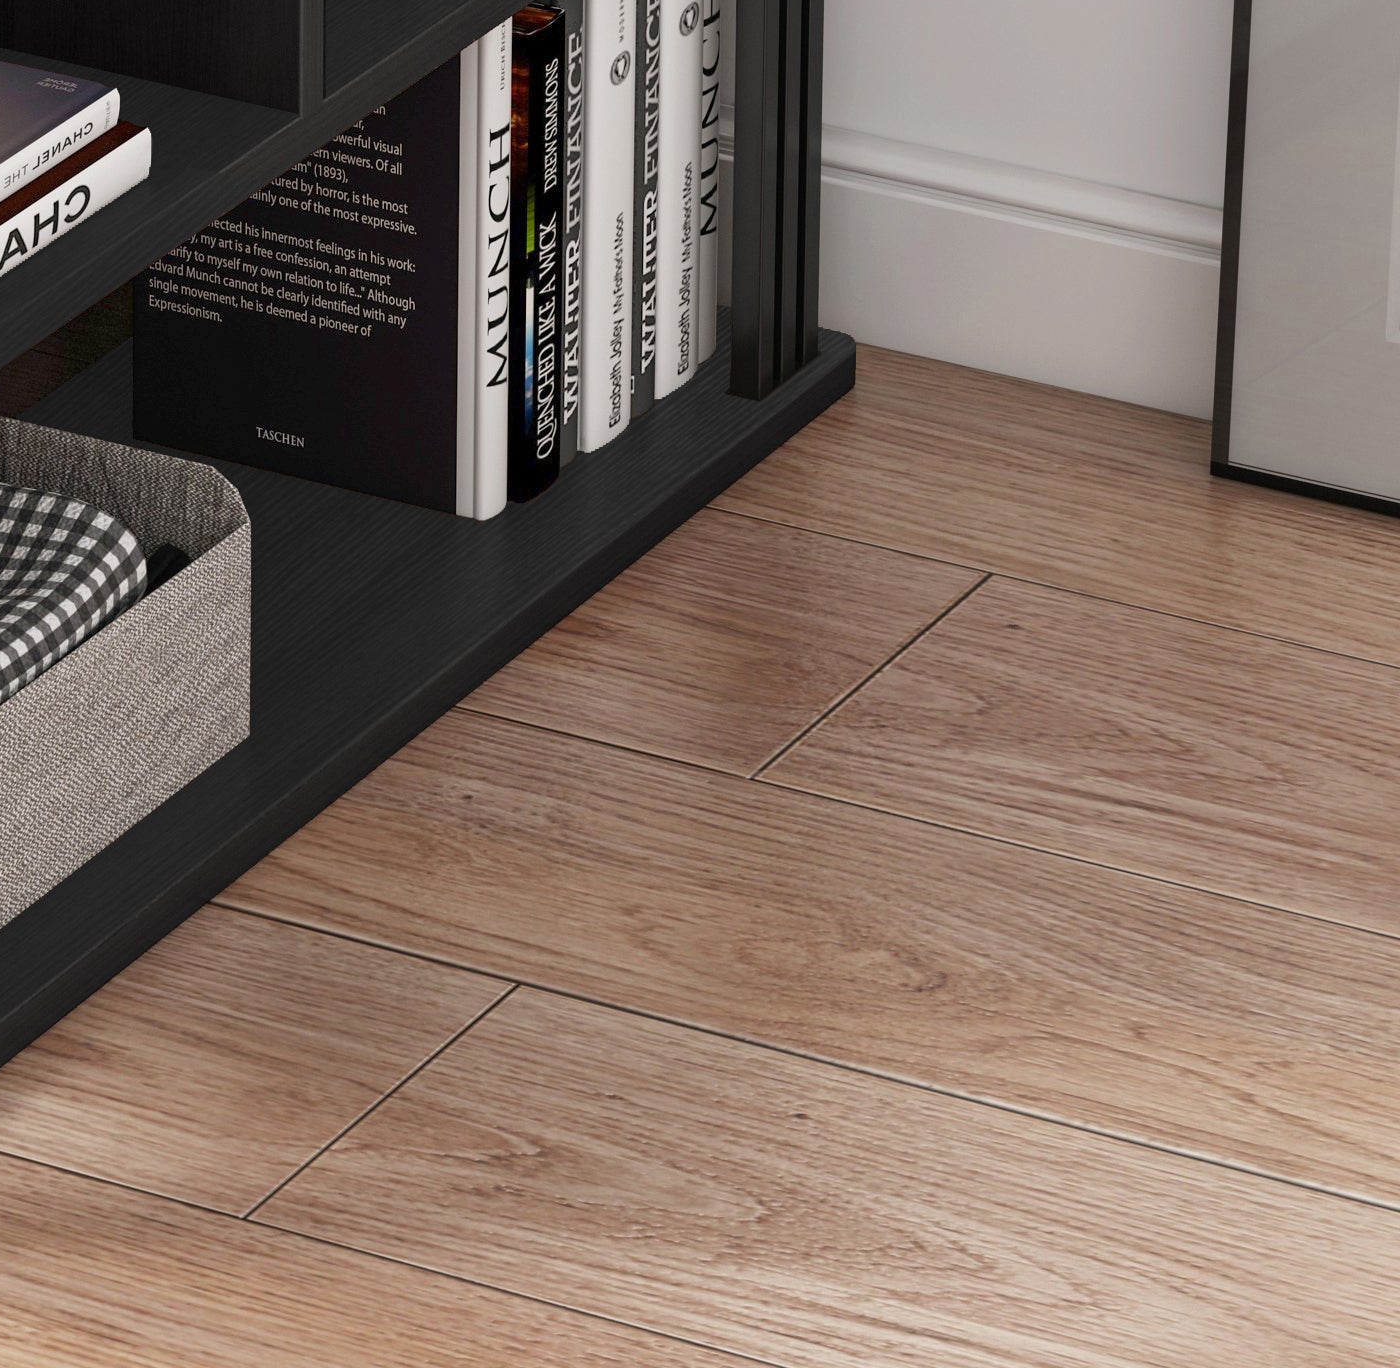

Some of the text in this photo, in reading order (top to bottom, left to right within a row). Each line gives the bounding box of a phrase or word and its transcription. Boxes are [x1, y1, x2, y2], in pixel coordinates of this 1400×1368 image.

[331, 150, 374, 169] viewers.
[375, 158, 389, 172] Of
[390, 162, 403, 176] all
[373, 140, 403, 156] visual
[313, 163, 349, 184] (1893),
[682, 161, 692, 200] Moon
[278, 197, 299, 209] one
[300, 200, 312, 212] of
[313, 201, 331, 216] the
[333, 207, 359, 223] most
[361, 214, 418, 236] expressive.
[300, 179, 314, 196] by
[315, 182, 350, 203] horror,
[352, 191, 360, 204] is
[362, 193, 380, 208] the
[381, 200, 408, 215] most
[244, 222, 260, 238] his
[261, 227, 314, 250] innermost
[316, 239, 356, 261] feelings
[358, 248, 368, 263] in
[370, 250, 385, 267] his
[387, 257, 416, 273] work:
[613, 212, 624, 250] Moon
[200, 234, 217, 249] my
[218, 238, 233, 251] art
[235, 240, 243, 253] is
[245, 245, 251, 254] a
[253, 243, 274, 259] free
[275, 250, 332, 274] confession,
[334, 264, 347, 276] an
[349, 267, 392, 286] attempt
[486, 121, 511, 388] MUNCH
[537, 57, 560, 460] QUENCHED LIKE A WICK DREW SIMMONS
[186, 265, 221, 285] Munch
[222, 275, 259, 293] cannot
[261, 282, 274, 297] be
[276, 286, 310, 307] clearly
[311, 294, 360, 316] identified
[363, 307, 385, 322] with
[387, 314, 407, 329] any
[194, 250, 205, 262] to
[207, 254, 241, 271] myself
[242, 262, 258, 277] my
[260, 267, 283, 280] own
[285, 271, 324, 290] relation
[326, 280, 337, 293] to
[367, 288, 416, 311] Although
[678, 266, 693, 307] Jolley
[149, 276, 372, 337] single movement, he is deemed a pioneer of
[149, 294, 223, 322] Expressionism.
[610, 318, 625, 359] Jolley
[677, 308, 690, 376] Elizabeth
[608, 360, 622, 428] Elizabeth
[255, 426, 305, 448] TASCHEN
